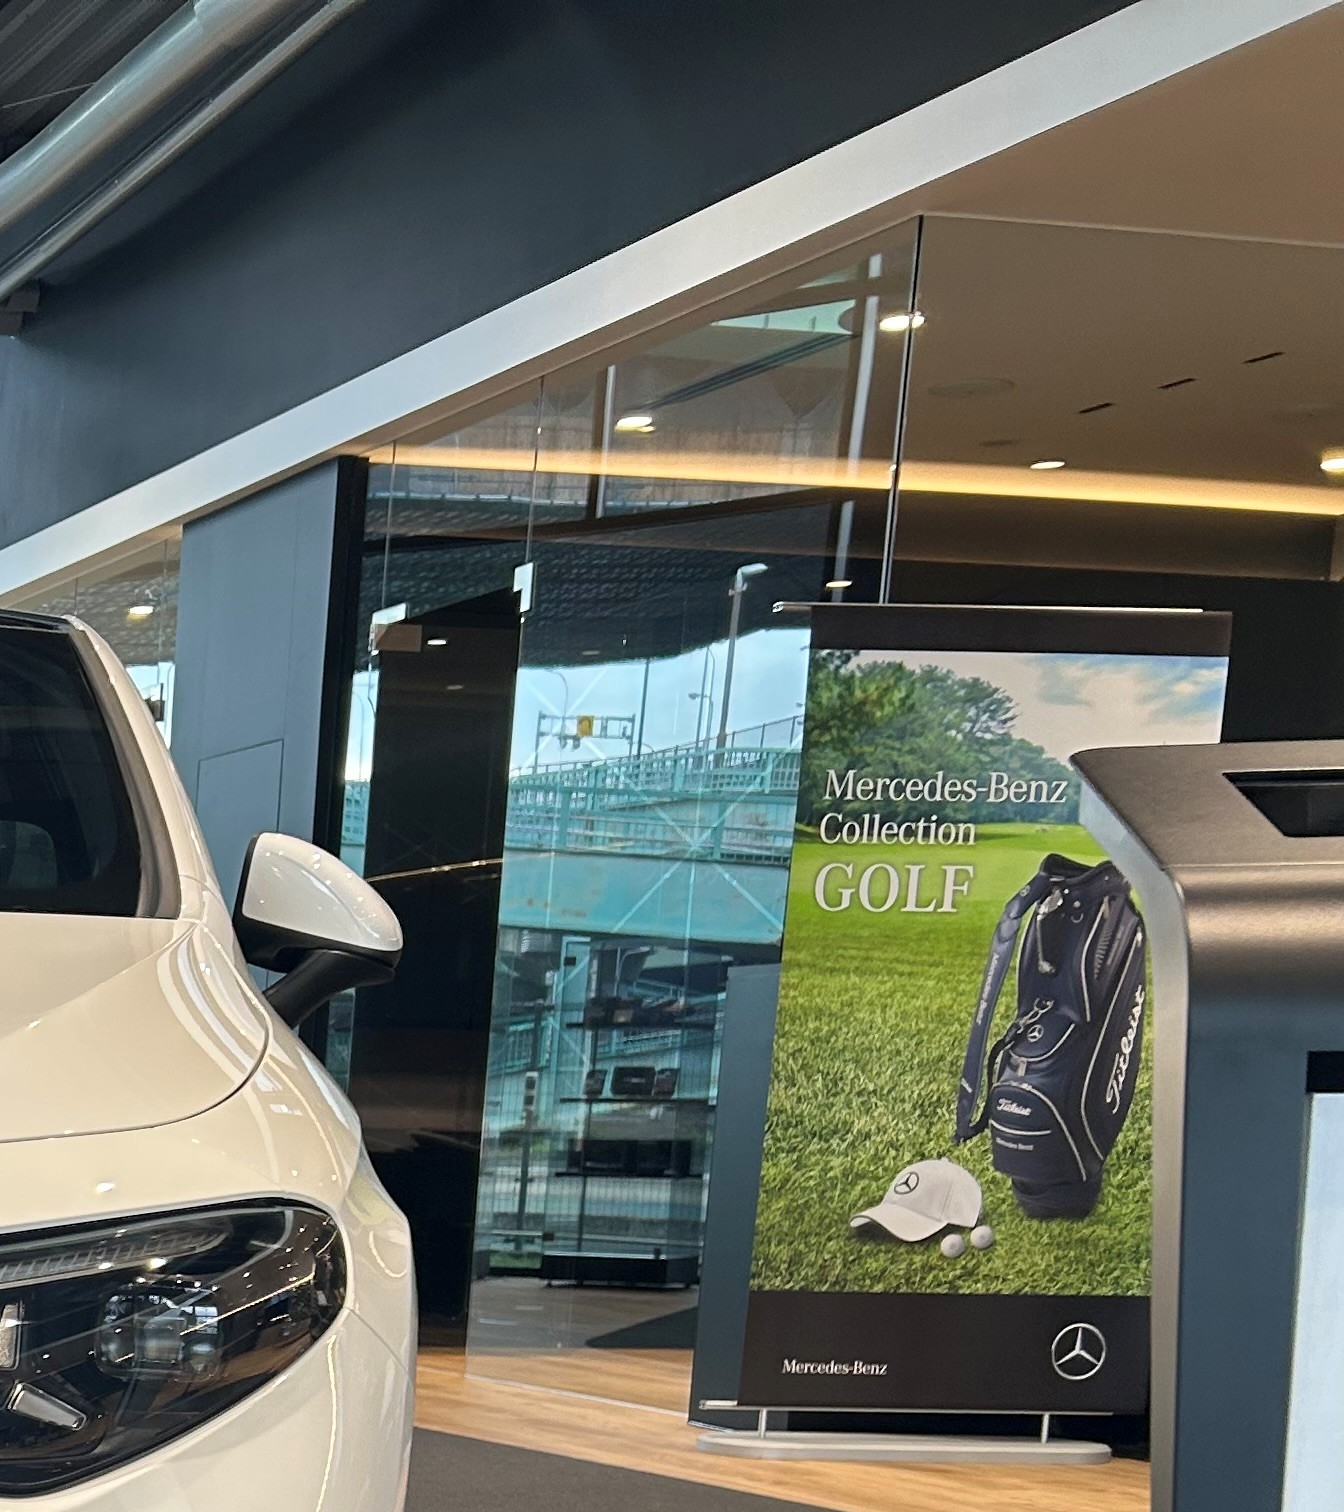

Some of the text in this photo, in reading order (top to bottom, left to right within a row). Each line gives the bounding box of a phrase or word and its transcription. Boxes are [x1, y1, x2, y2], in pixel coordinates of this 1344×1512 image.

[822, 768, 1069, 804] Mercedes-Benz
[819, 812, 977, 846] Collection
[814, 862, 975, 913] GOLF
[1105, 984, 1146, 1115] Titleist
[781, 1358, 889, 1376] Mercedes-Benz
